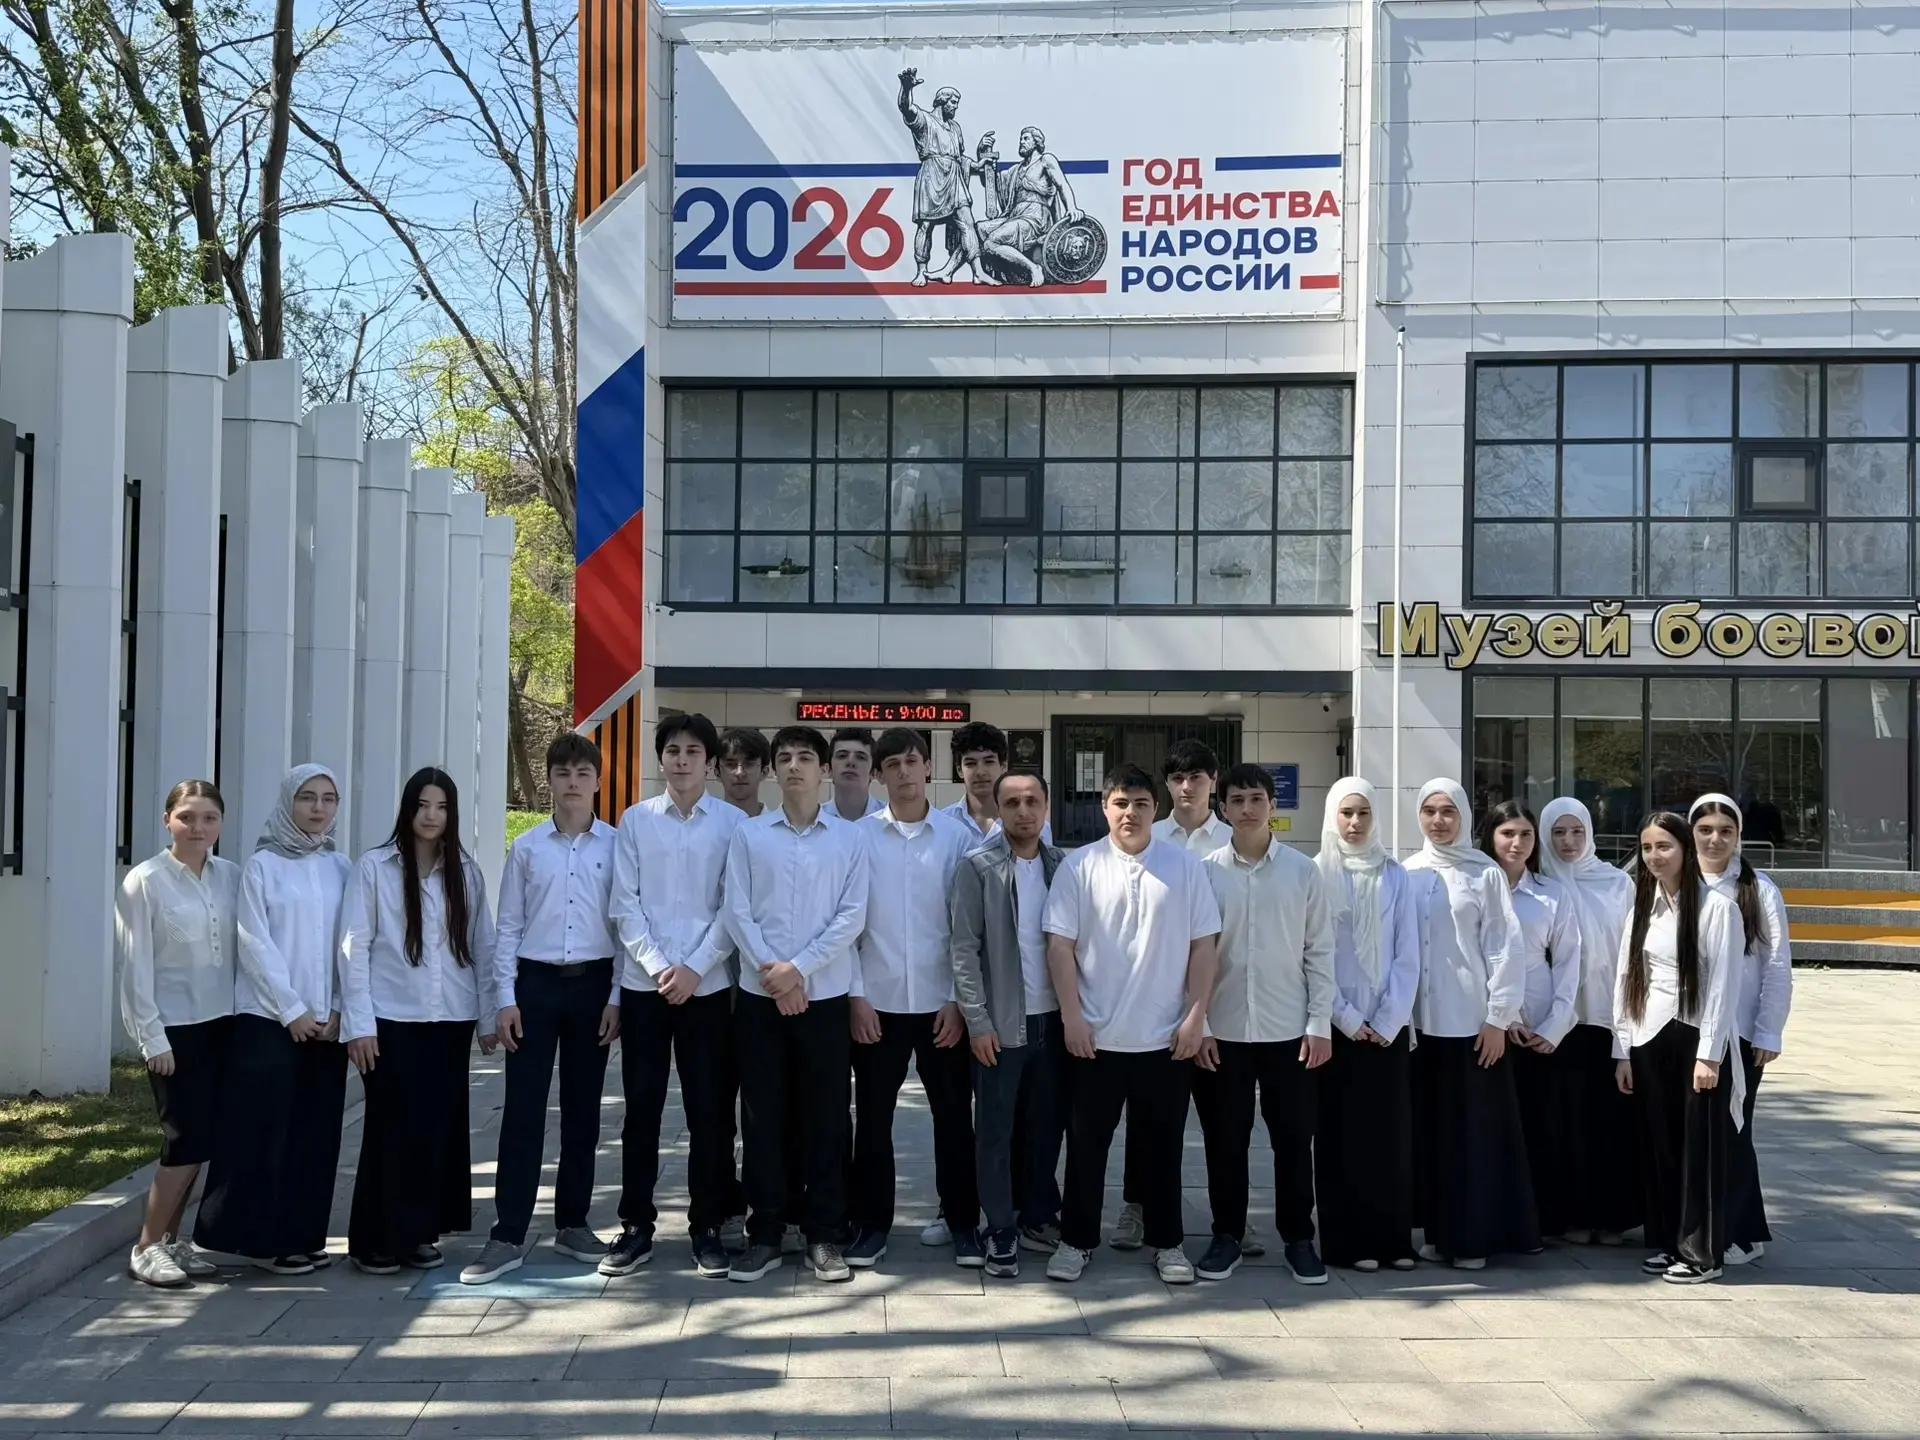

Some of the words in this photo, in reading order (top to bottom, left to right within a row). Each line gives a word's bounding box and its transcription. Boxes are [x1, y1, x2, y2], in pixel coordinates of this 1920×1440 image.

[1123, 158, 1203, 190] ГОД
[1122, 190, 1341, 227] ЕДИНСТВА
[673, 186, 905, 272] 2026
[1121, 226, 1319, 260] НАРОДОВ
[1121, 263, 1291, 293] РОССИИ
[1377, 600, 1631, 670] Музей
[1652, 600, 1920, 658] боево
[800, 704, 879, 719] РЕСЕНЬЕ
[900, 705, 935, 719] 9:00
